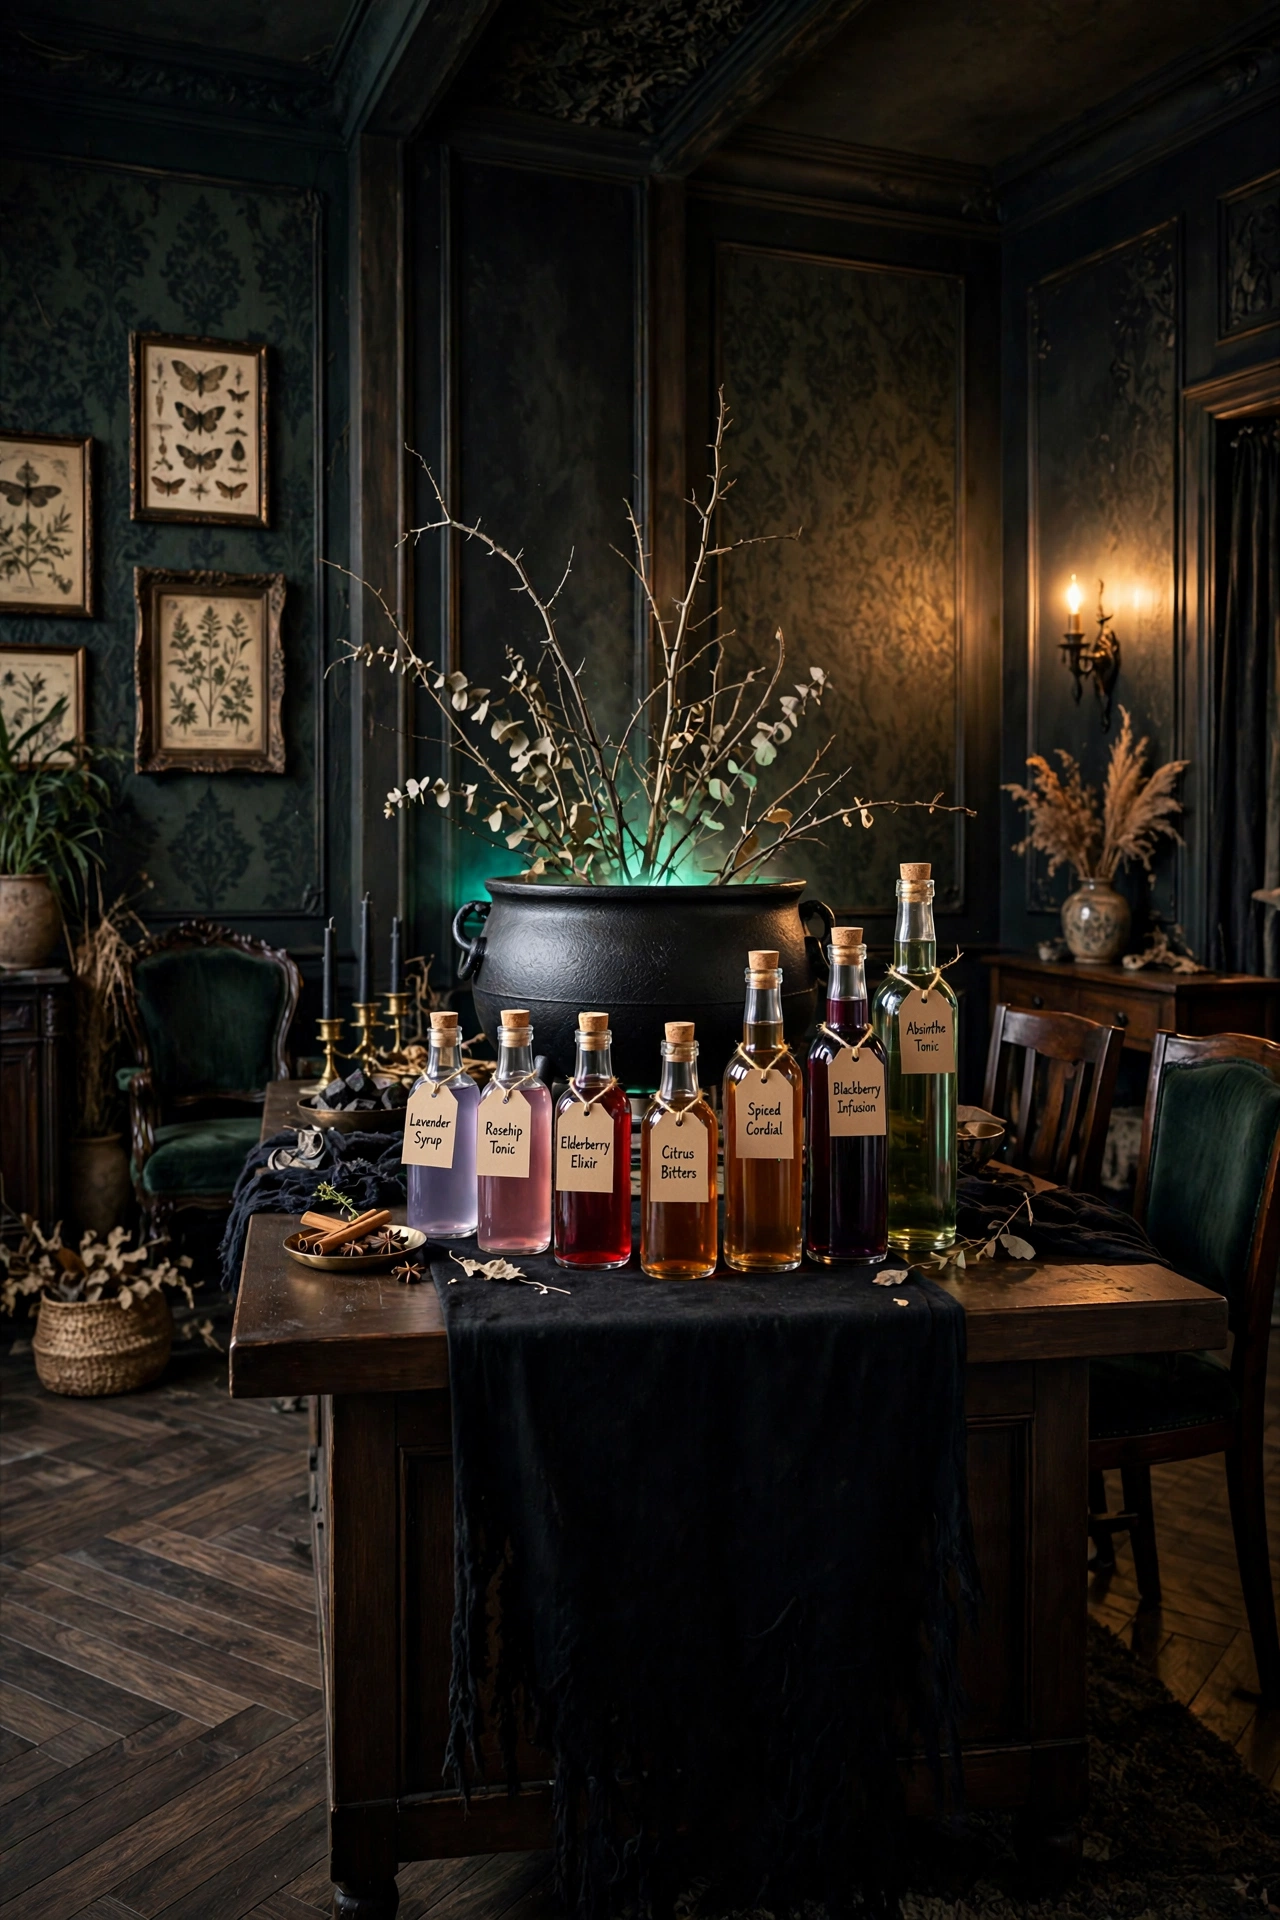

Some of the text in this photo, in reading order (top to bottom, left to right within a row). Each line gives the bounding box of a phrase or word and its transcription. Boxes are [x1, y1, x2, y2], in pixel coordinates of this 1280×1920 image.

[907, 1021, 945, 1035] Absinthe
[914, 1039, 939, 1051] Tonic
[834, 1082, 880, 1098] Blackberry
[748, 1102, 781, 1120] Spiced
[837, 1100, 875, 1116] Infusion
[410, 1113, 450, 1128] Lavender
[486, 1122, 522, 1141] Rosehip
[746, 1121, 782, 1135] Cordial
[414, 1131, 442, 1150] Syrup
[490, 1141, 515, 1154] Tonic
[561, 1136, 610, 1154] Elderberry
[662, 1145, 694, 1159] Citrus
[571, 1154, 597, 1168] Elixir
[662, 1165, 696, 1179] Bitters
